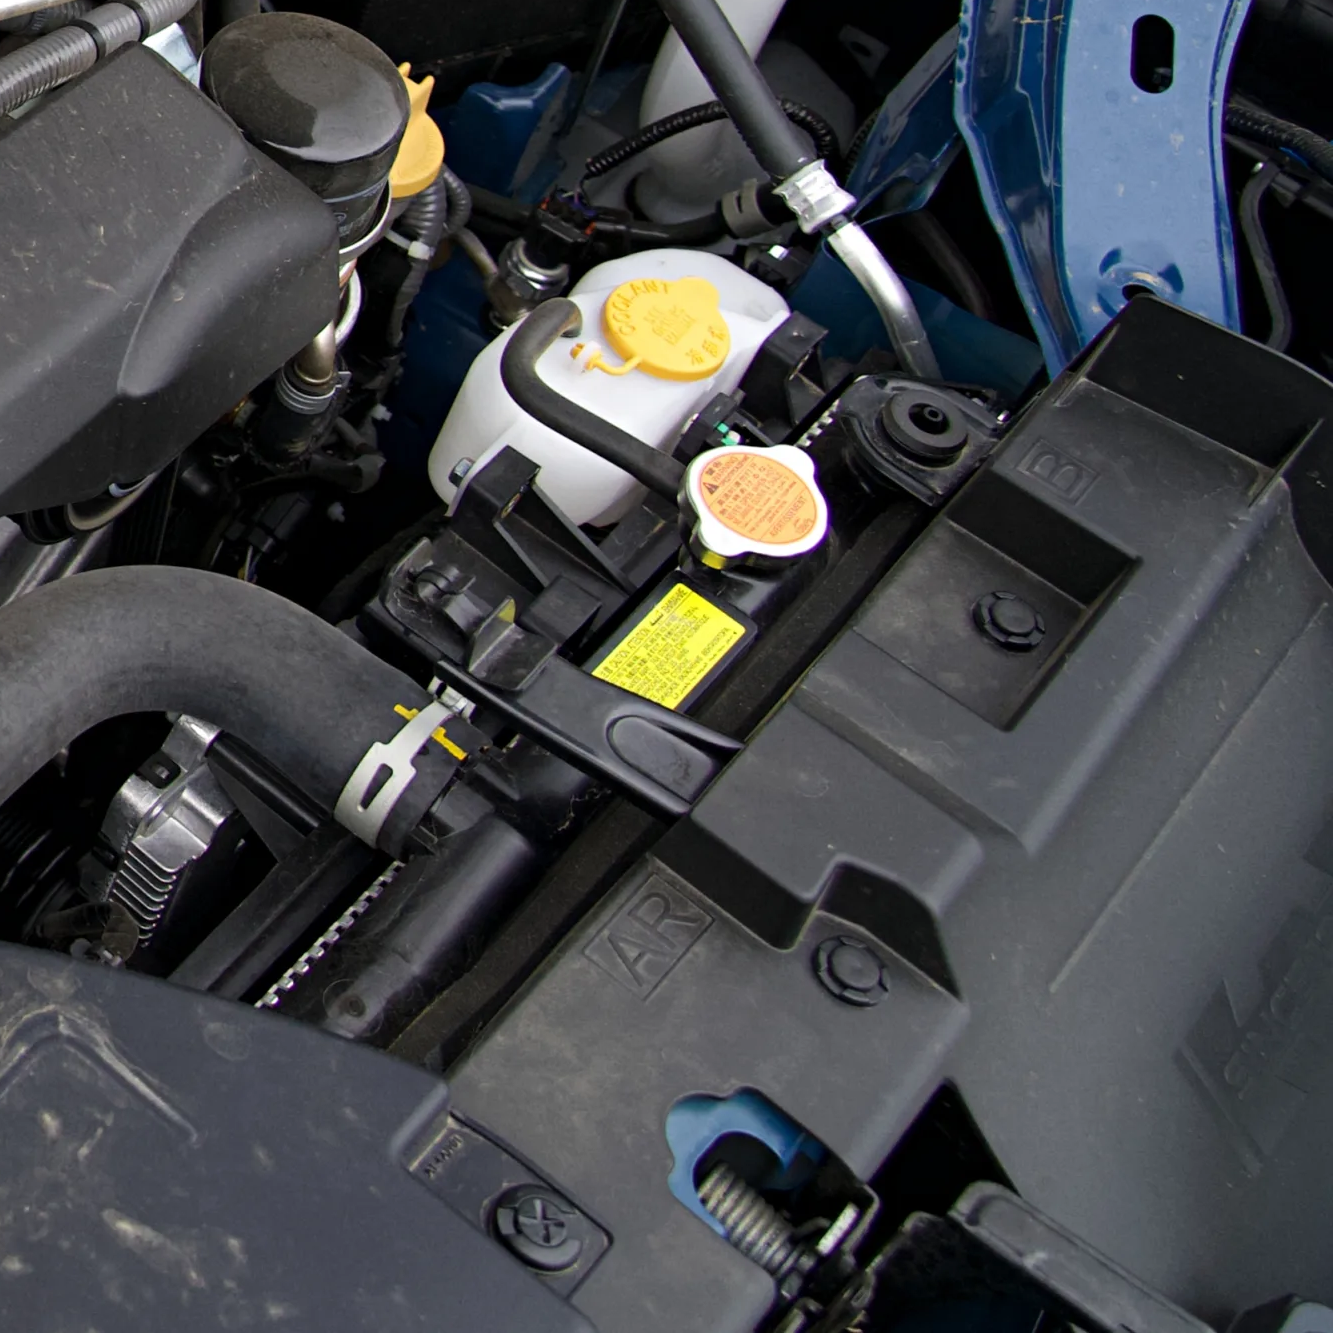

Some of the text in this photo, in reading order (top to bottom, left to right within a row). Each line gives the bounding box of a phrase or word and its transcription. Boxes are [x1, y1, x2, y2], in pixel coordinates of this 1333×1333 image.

[617, 276, 675, 338] COOLANT
[1023, 450, 1078, 490] B
[608, 891, 700, 987] AR
